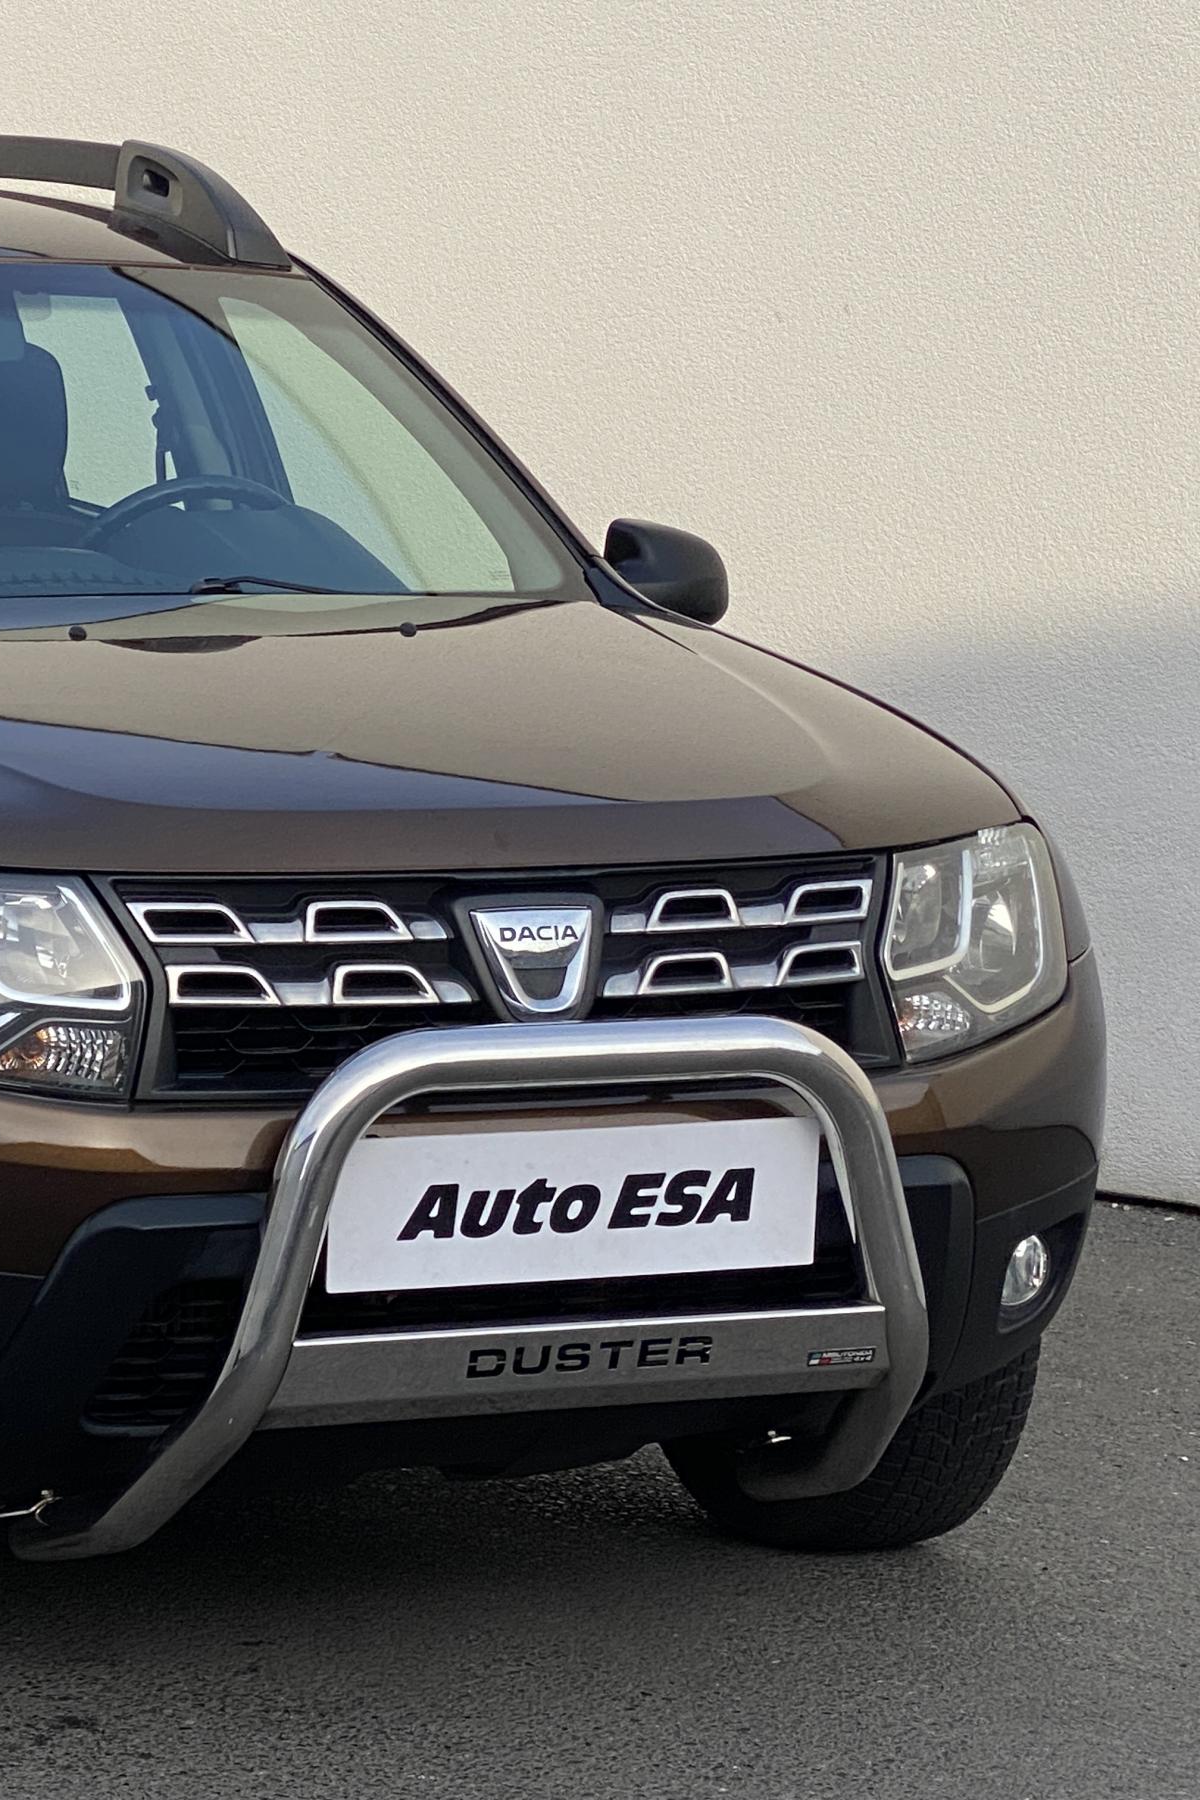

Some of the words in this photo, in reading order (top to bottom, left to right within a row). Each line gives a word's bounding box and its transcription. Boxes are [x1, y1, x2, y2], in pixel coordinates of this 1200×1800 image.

[500, 925, 579, 942] DACIA
[396, 1178, 601, 1242] Auto
[607, 1167, 755, 1230] ESA
[466, 1335, 713, 1378] DUSTER
